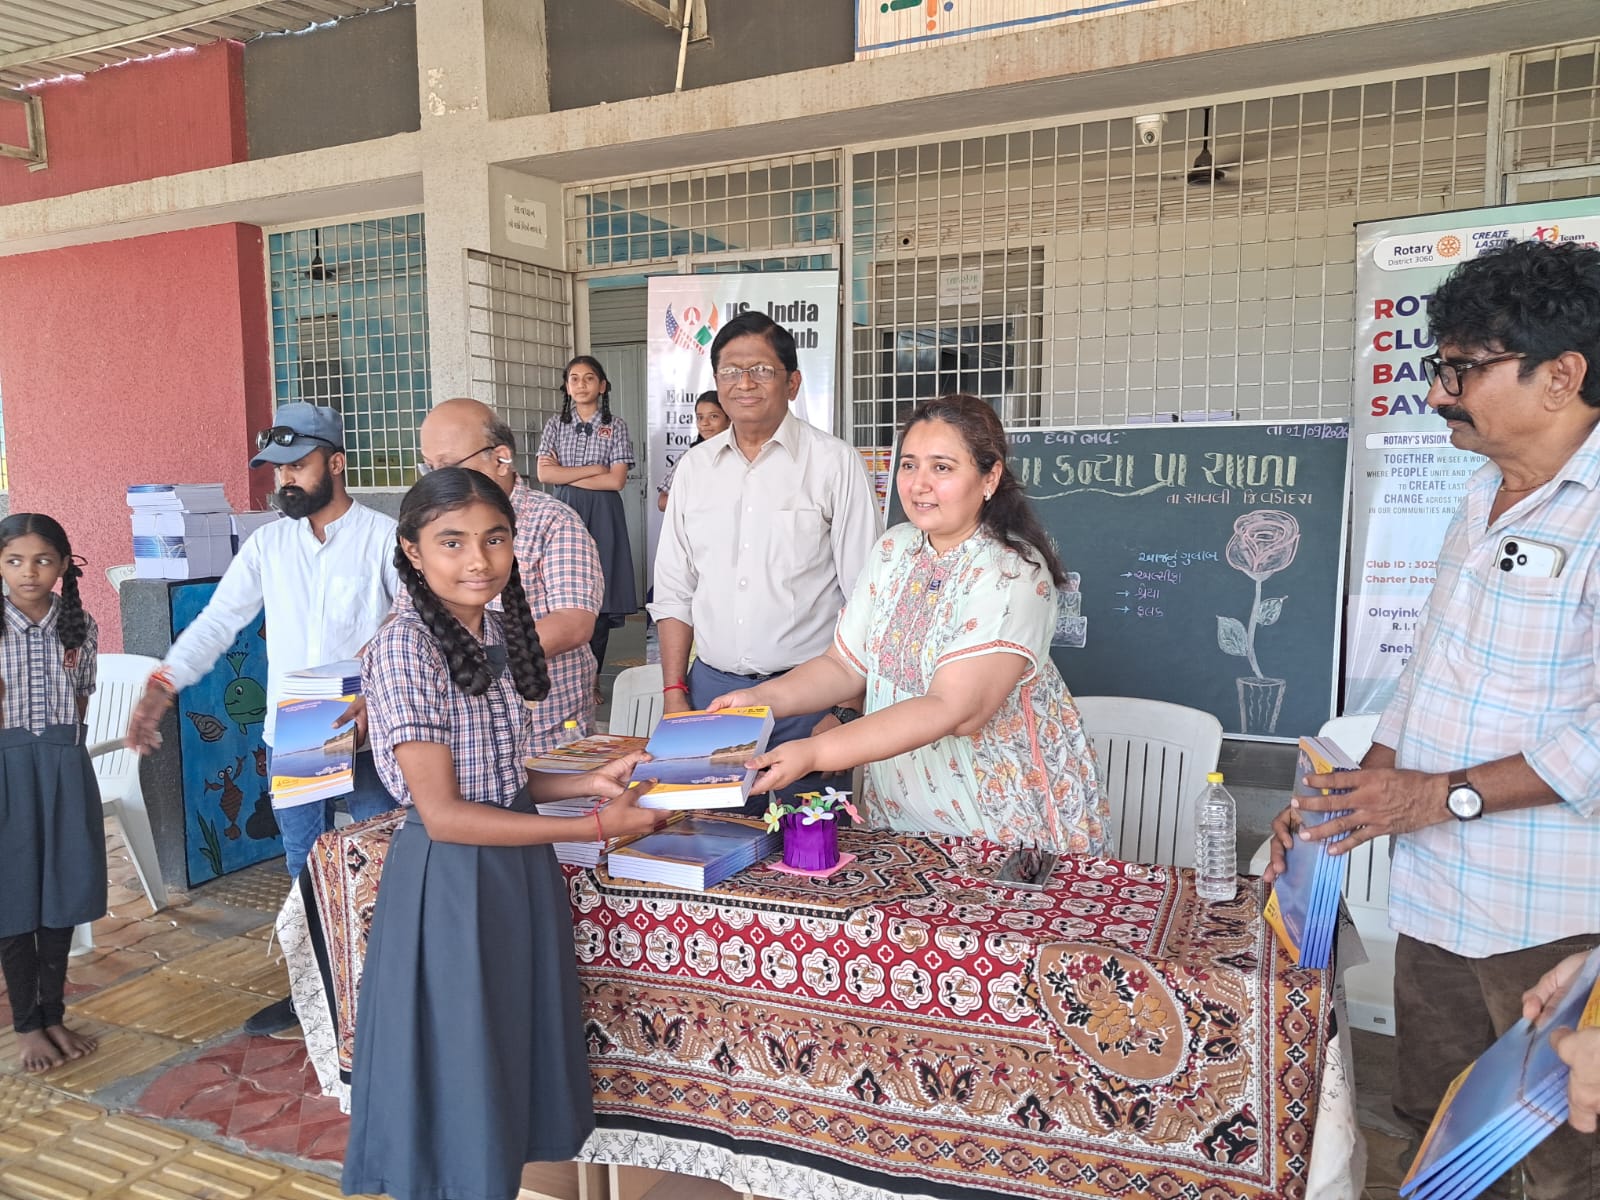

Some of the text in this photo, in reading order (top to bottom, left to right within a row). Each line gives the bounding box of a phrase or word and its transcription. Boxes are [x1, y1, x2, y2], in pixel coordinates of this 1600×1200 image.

[1472, 230, 1510, 240] CREATE
[1560, 234, 1585, 242] Team
[1394, 245, 1434, 256] Rotary
[1388, 255, 1434, 266] District 3060
[767, 300, 819, 322] India
[1370, 394, 1439, 417] SAY
[1384, 434, 1447, 445] ROTARY'S VISION
[1384, 453, 1435, 464] TOGETHER
[1366, 470, 1389, 478] WHERE
[1391, 467, 1428, 477] PEOPLE
[1409, 480, 1446, 491] CREATE
[1384, 494, 1424, 504] CHANGE
[1366, 560, 1391, 569] Club
[1394, 560, 1406, 569] ID
[1365, 575, 1437, 584] Charter Date
